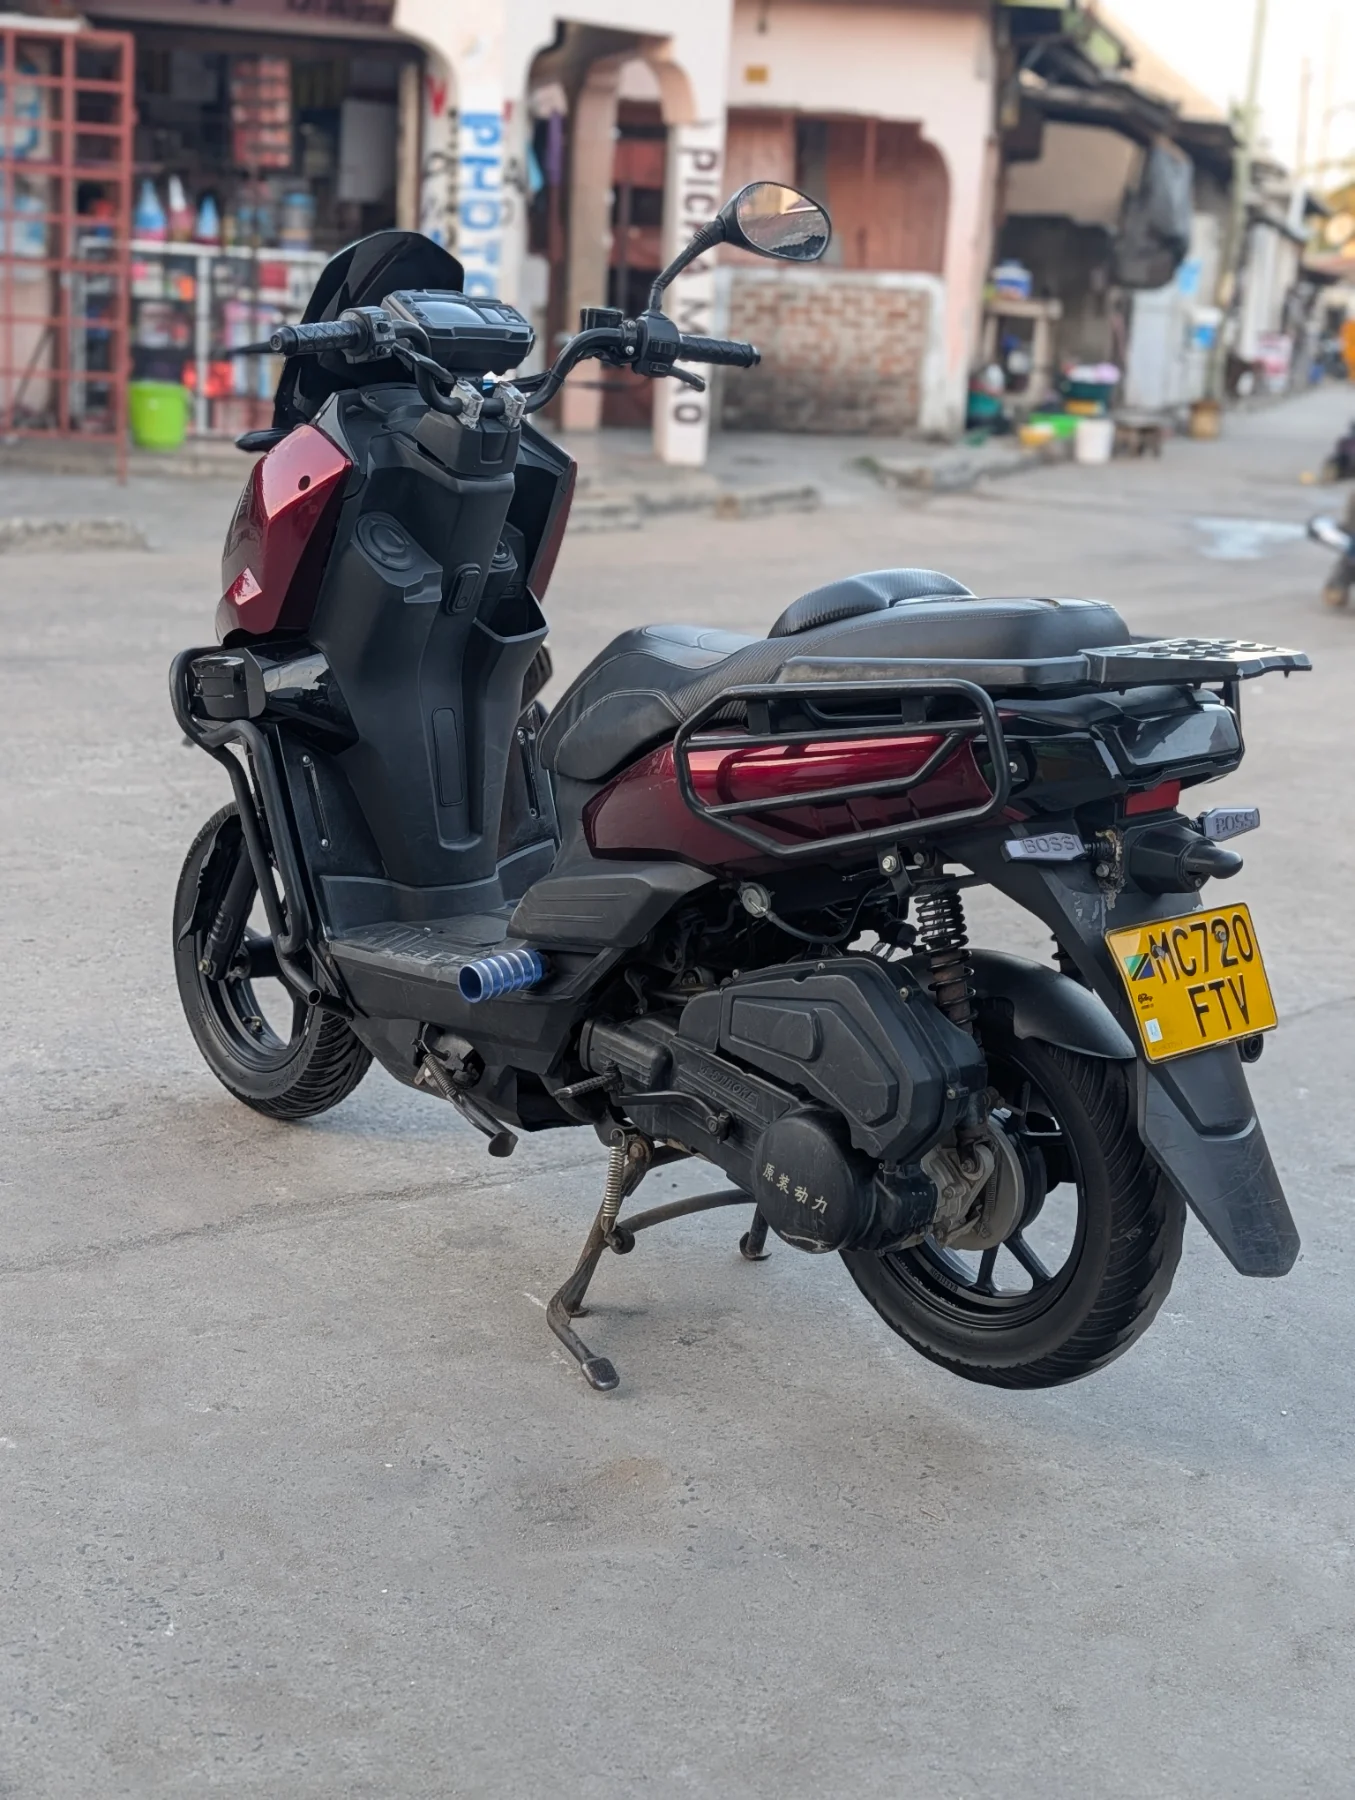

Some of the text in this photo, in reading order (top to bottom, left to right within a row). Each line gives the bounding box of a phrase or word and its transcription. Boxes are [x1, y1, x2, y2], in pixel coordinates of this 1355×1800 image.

[1022, 835, 1076, 854] BOSS
[1215, 811, 1254, 834] BOSS
[1147, 913, 1254, 984] MC720
[1186, 973, 1251, 1038] FTV
[762, 1161, 829, 1216] 原装动力
